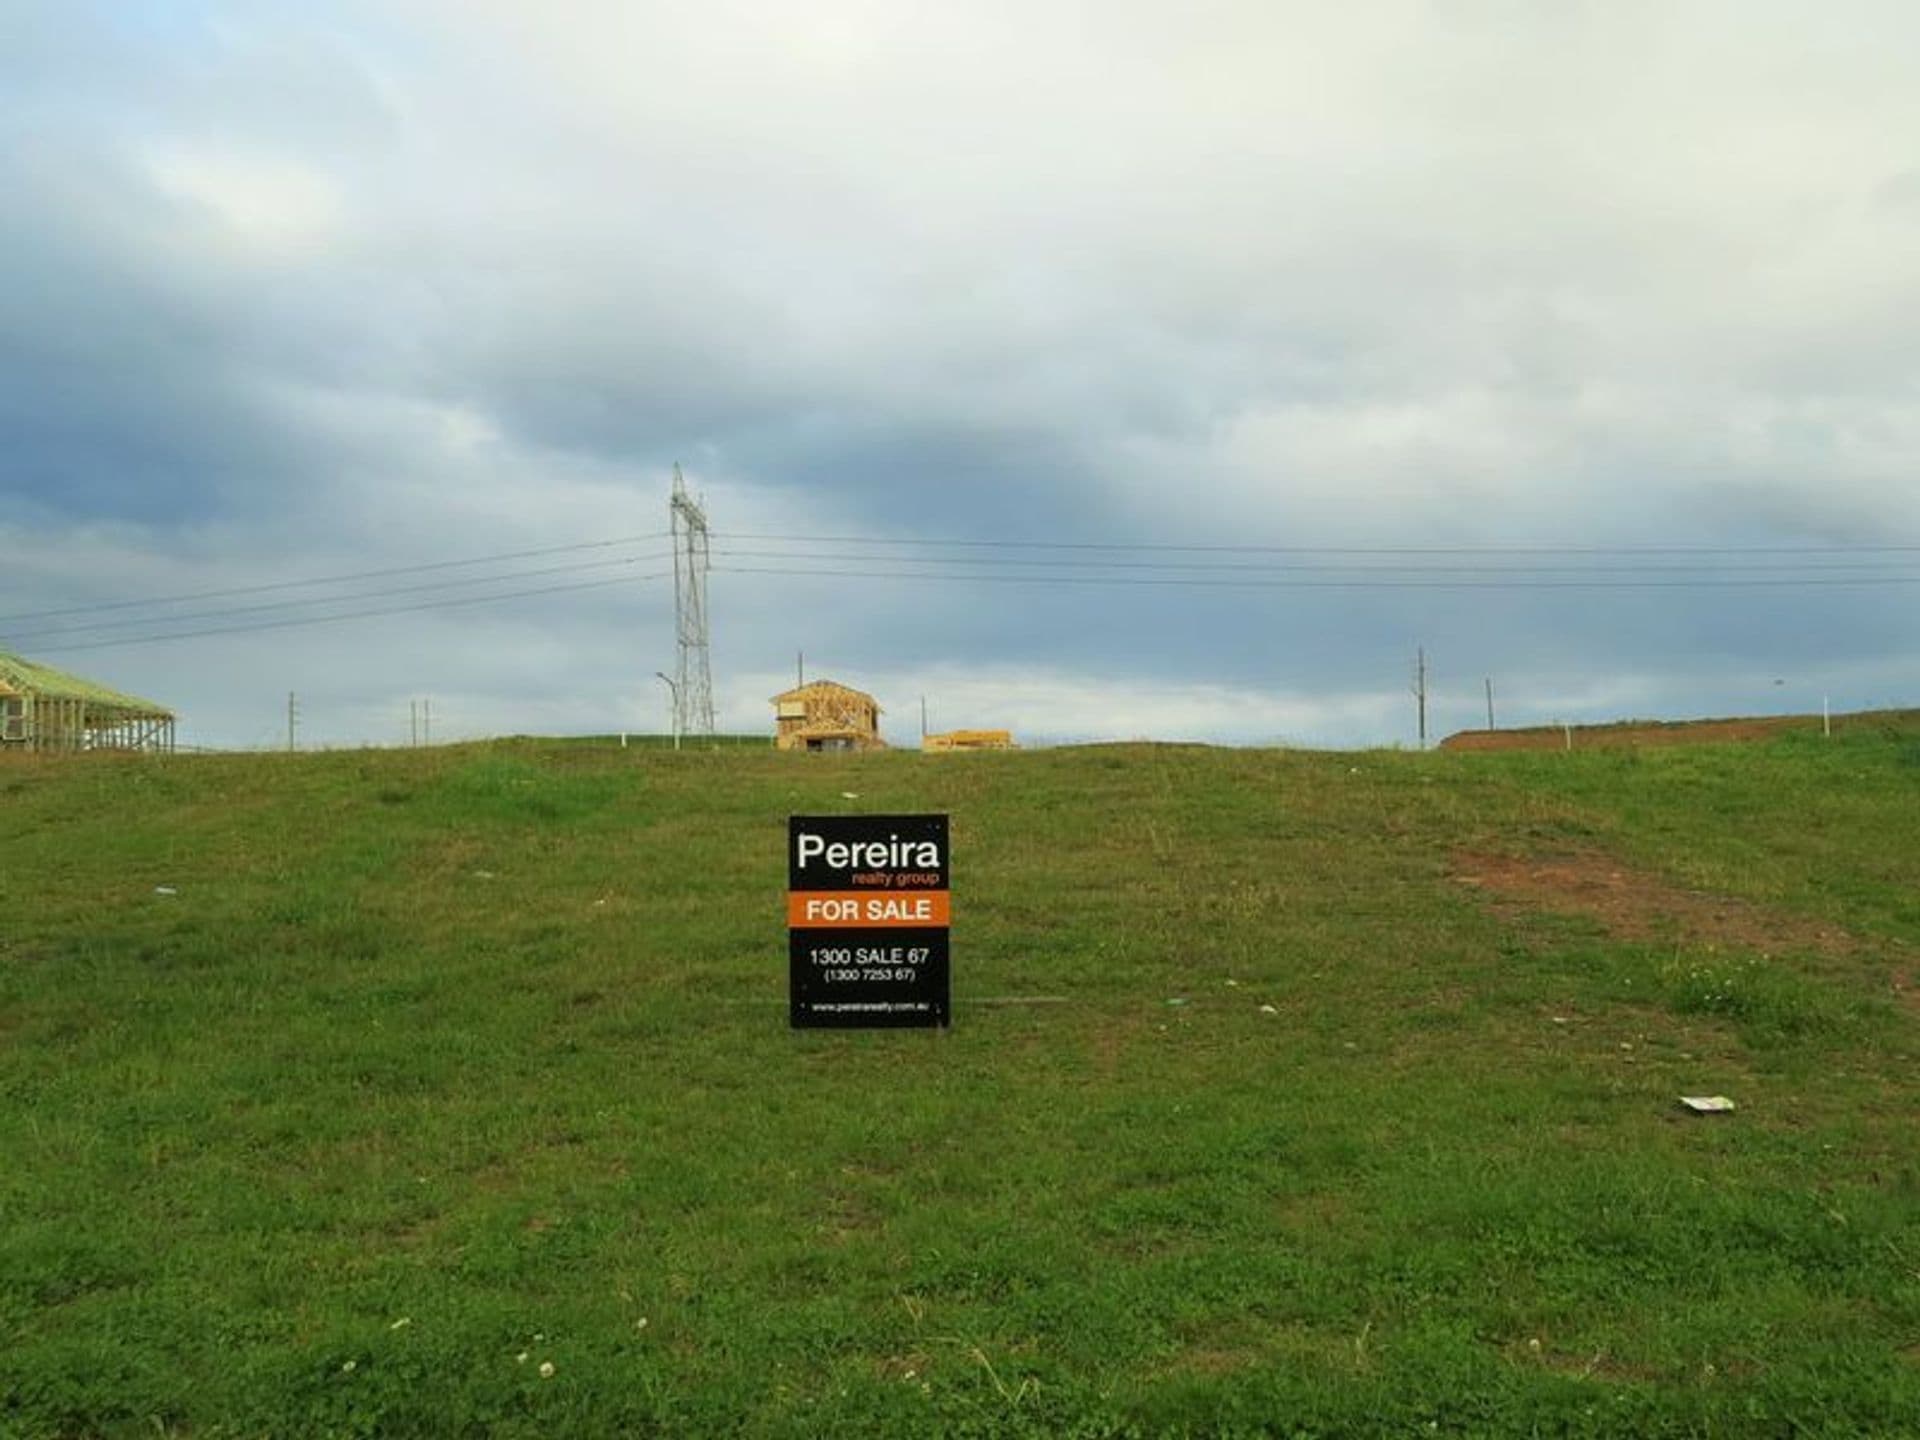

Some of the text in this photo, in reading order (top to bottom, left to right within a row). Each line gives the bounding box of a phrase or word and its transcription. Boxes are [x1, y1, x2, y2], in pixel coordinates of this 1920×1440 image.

[797, 833, 940, 869] Pereira
[852, 871, 940, 887] realty group
[806, 900, 932, 921] FOR SALE
[810, 948, 929, 964] 1300 SALE 67
[824, 968, 860, 983] (1300
